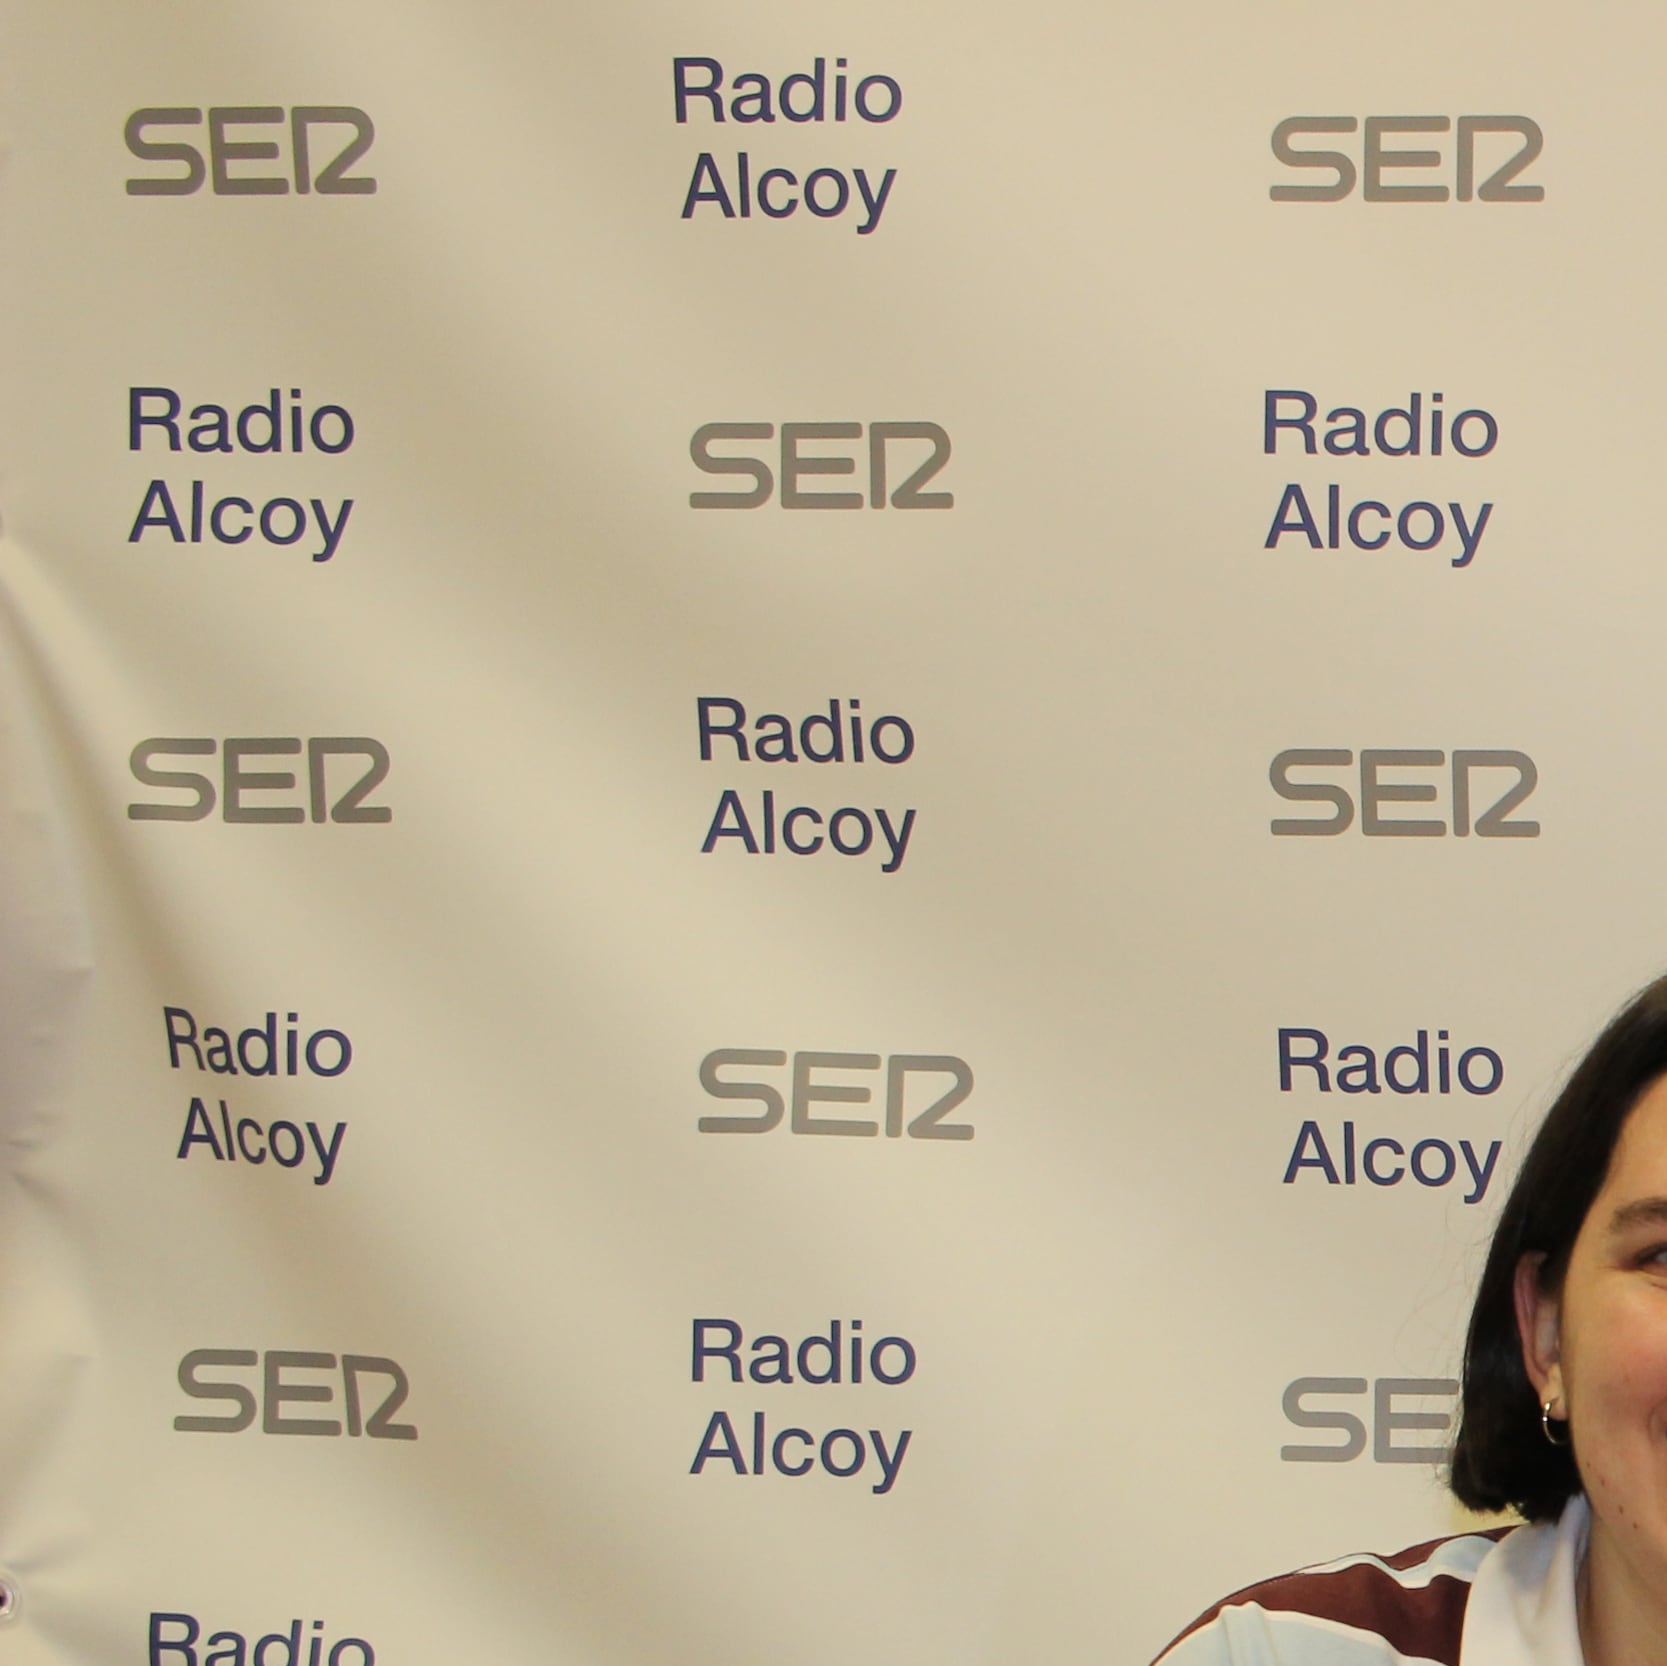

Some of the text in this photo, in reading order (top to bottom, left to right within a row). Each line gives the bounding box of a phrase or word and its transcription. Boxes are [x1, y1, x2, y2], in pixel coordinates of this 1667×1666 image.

[673, 57, 902, 123] Radio
[124, 106, 377, 196] SER
[1270, 115, 1544, 202] SER
[681, 152, 897, 235] Alcoy
[129, 387, 354, 454] Radio
[1264, 390, 1498, 458] Radio
[689, 421, 954, 509] SER
[127, 479, 354, 563] Alcoy
[1264, 483, 1493, 568] Alcoy
[696, 697, 915, 764] Radio
[127, 737, 392, 824] SER
[1269, 749, 1540, 837] SER
[700, 789, 917, 873] Alcoy
[162, 1005, 352, 1077] Radio
[1278, 1028, 1504, 1096] Radio
[698, 1049, 974, 1140] SER
[176, 1097, 347, 1186] Alcoy
[1282, 1120, 1502, 1204] Alcoy
[691, 1318, 916, 1385] Radio
[173, 1349, 418, 1441] SER
[1281, 1377, 1460, 1463] SE
[689, 1411, 912, 1495] Alcoy
